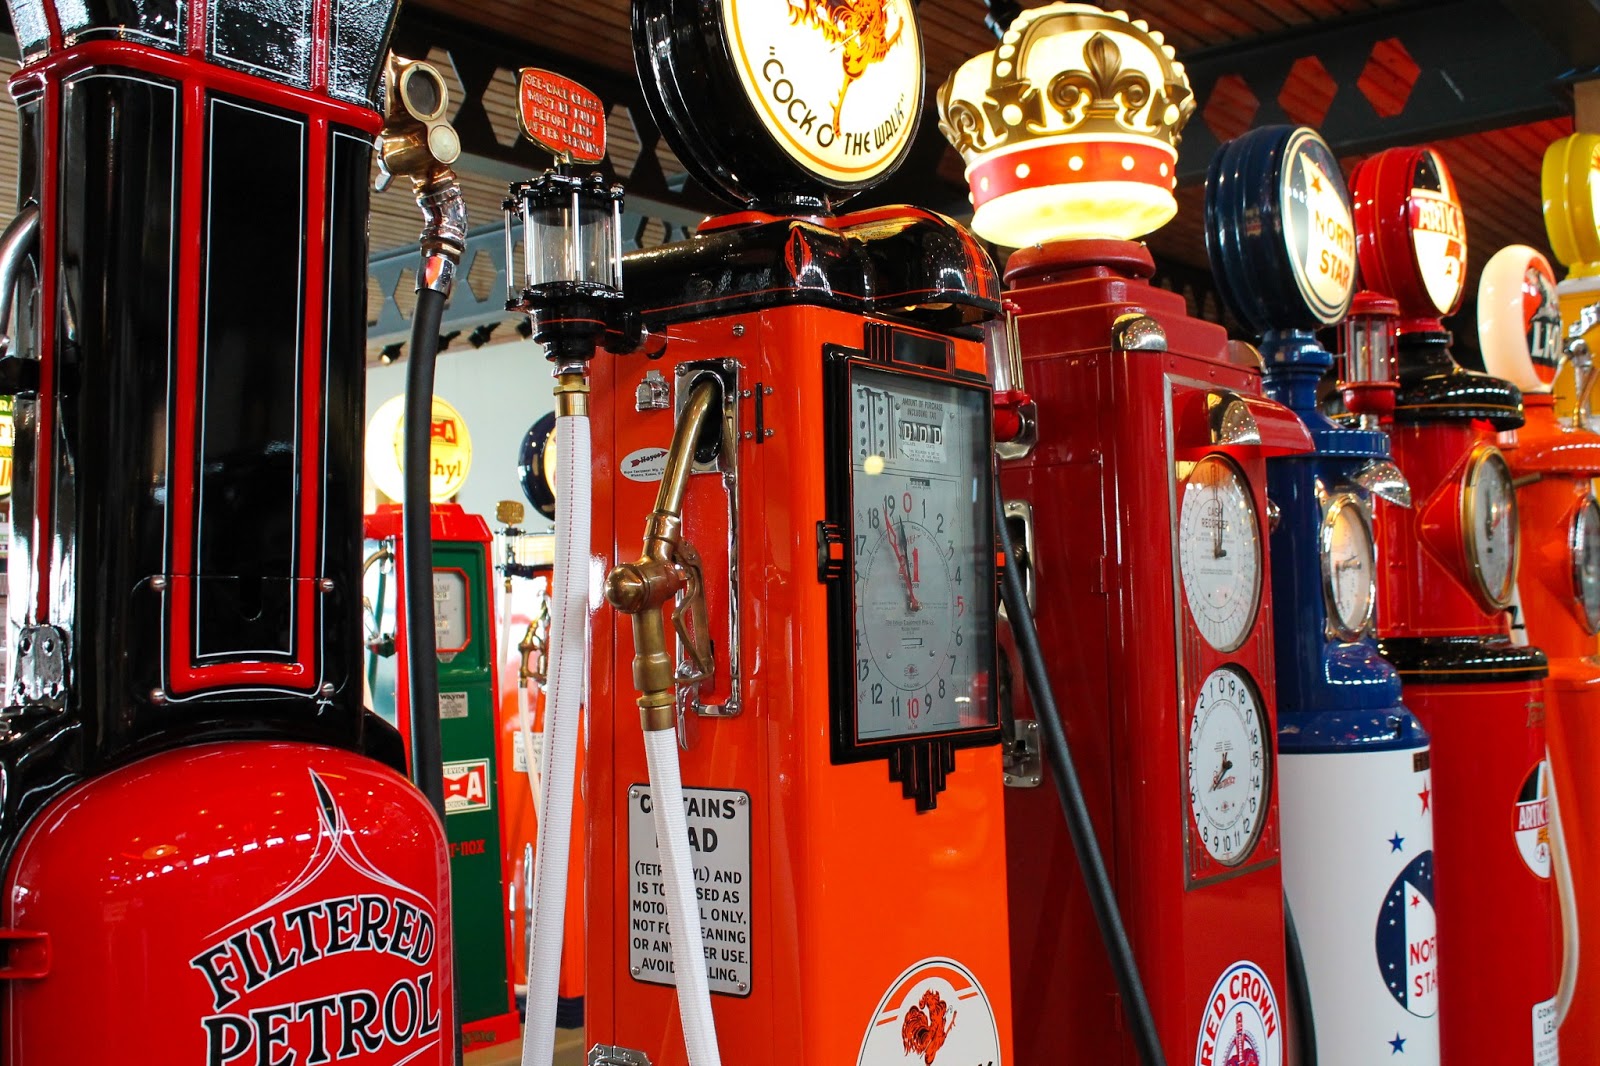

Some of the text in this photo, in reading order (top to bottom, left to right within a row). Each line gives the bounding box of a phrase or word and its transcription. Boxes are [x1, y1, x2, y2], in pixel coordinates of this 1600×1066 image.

[527, 89, 554, 110] MUST
[533, 106, 567, 130] BEFORE
[528, 120, 560, 141] AFTER
[844, 131, 871, 156] THE
[1319, 249, 1350, 290] STAR
[1530, 321, 1561, 359] LIO
[434, 458, 461, 484] hyl
[883, 495, 896, 517] 19
[903, 492, 912, 513] 0
[922, 499, 926, 519] 1
[867, 508, 880, 529] 18
[936, 513, 944, 533] 2
[855, 534, 867, 556] 17
[947, 540, 955, 561] 3
[954, 566, 962, 586] 4
[957, 596, 964, 618] 5
[955, 625, 963, 646] 6
[856, 659, 870, 682] 13
[949, 655, 957, 675] 7
[871, 683, 883, 704] 12
[938, 679, 946, 699] 8
[1219, 677, 1225, 693] 0
[1228, 680, 1235, 697] 19
[891, 696, 900, 717] 11
[924, 693, 932, 715] 9
[1200, 692, 1205, 709] 2
[1238, 688, 1246, 705] 18
[907, 698, 919, 719] 10
[1251, 728, 1258, 745] 16
[1252, 775, 1260, 791] 14
[1249, 797, 1257, 814] 13
[1203, 826, 1209, 843] 8
[1242, 818, 1250, 834] 12
[1213, 836, 1219, 853] 9
[1222, 835, 1231, 852] 10
[1234, 830, 1241, 847] 11
[637, 881, 649, 894] IS
[713, 870, 742, 885] AND
[696, 887, 740, 904] SED AS
[633, 900, 668, 915] MOTO
[633, 918, 656, 933] NOT
[700, 927, 746, 944] EANING
[189, 894, 436, 1013] FILTERED
[633, 937, 649, 950] OR
[641, 957, 676, 974] AVOID
[721, 948, 749, 964] USE.
[706, 968, 740, 983] LING.
[1414, 968, 1438, 998] STA
[201, 971, 441, 1066] PETROL
[1201, 972, 1276, 1066] RED CROWN
